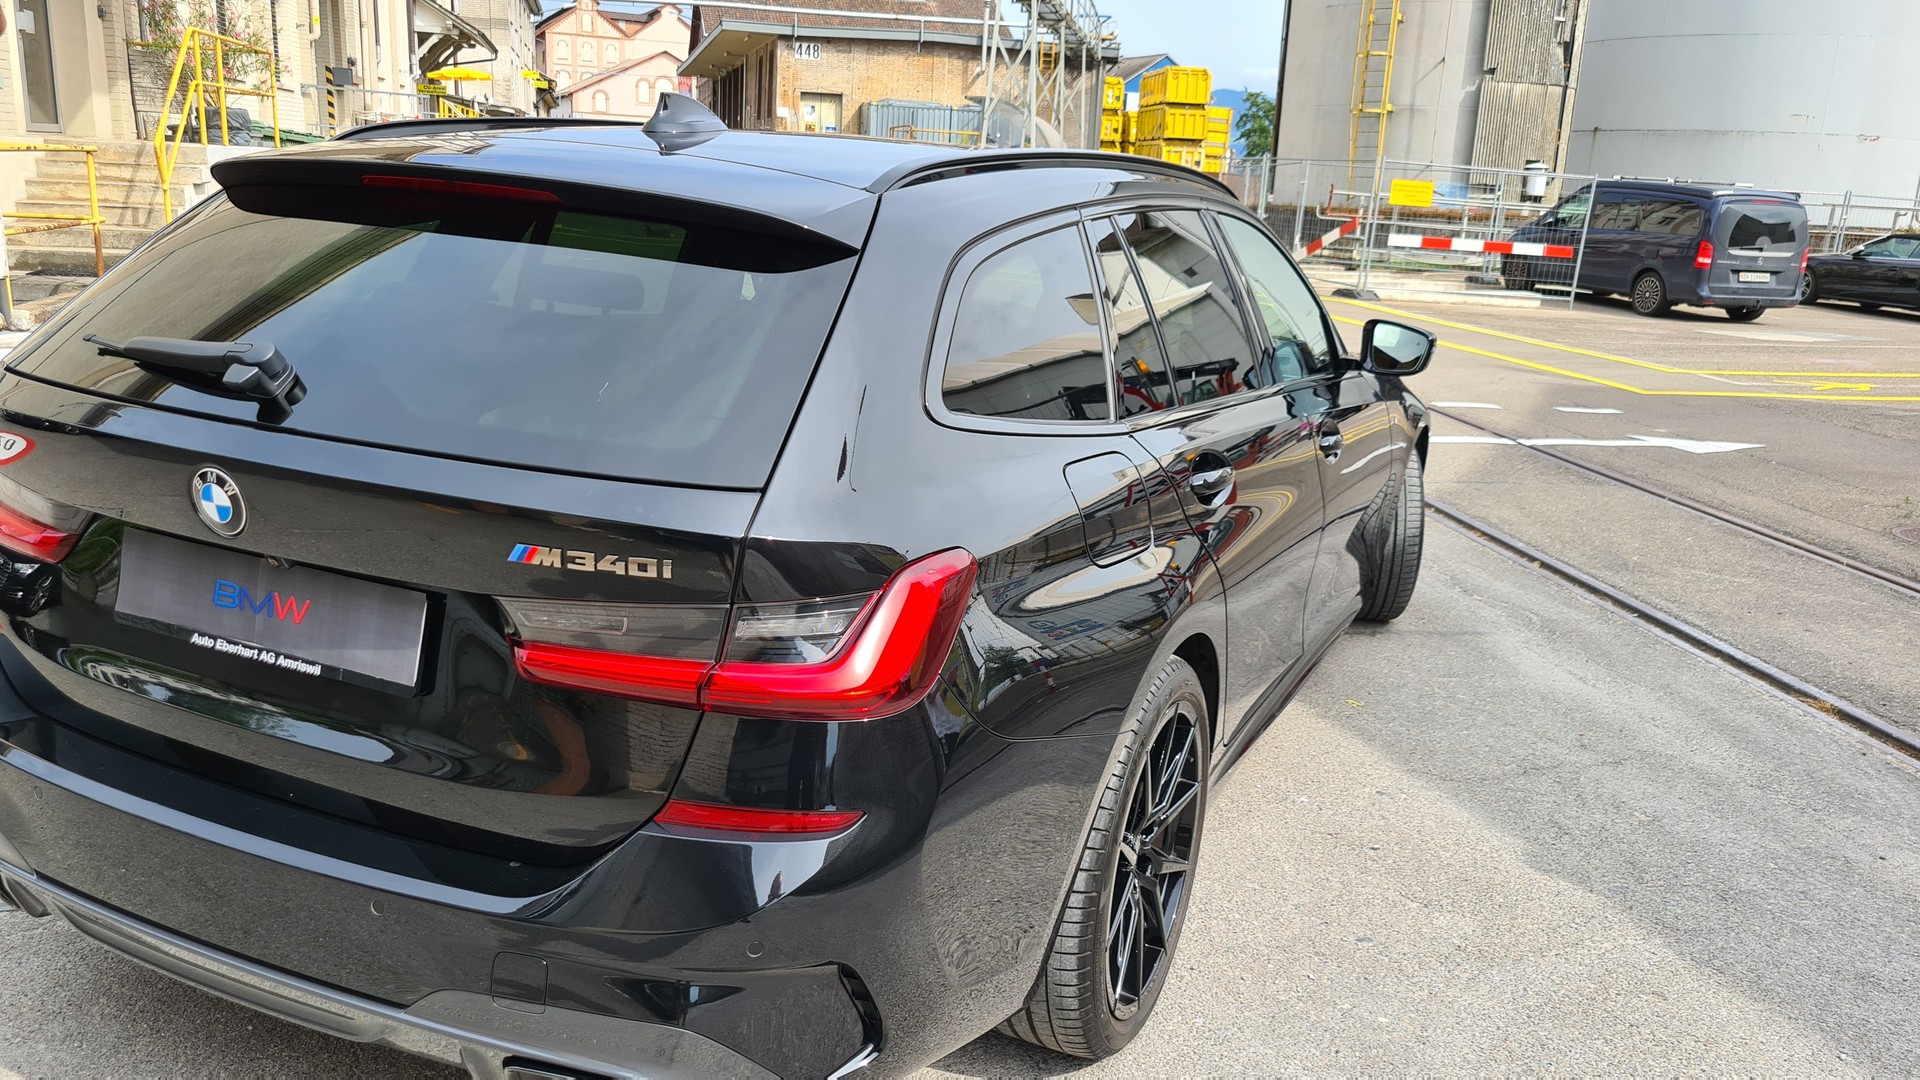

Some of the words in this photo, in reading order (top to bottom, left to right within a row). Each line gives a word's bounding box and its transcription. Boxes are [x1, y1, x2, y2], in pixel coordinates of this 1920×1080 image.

[796, 44, 820, 59] 448
[195, 471, 237, 497] BMW
[529, 546, 673, 579] M340i
[213, 578, 312, 625] BMW
[190, 632, 215, 647] Auto
[215, 638, 259, 660] Eberhart
[259, 650, 276, 664] AG
[275, 654, 321, 676] Amriswil
